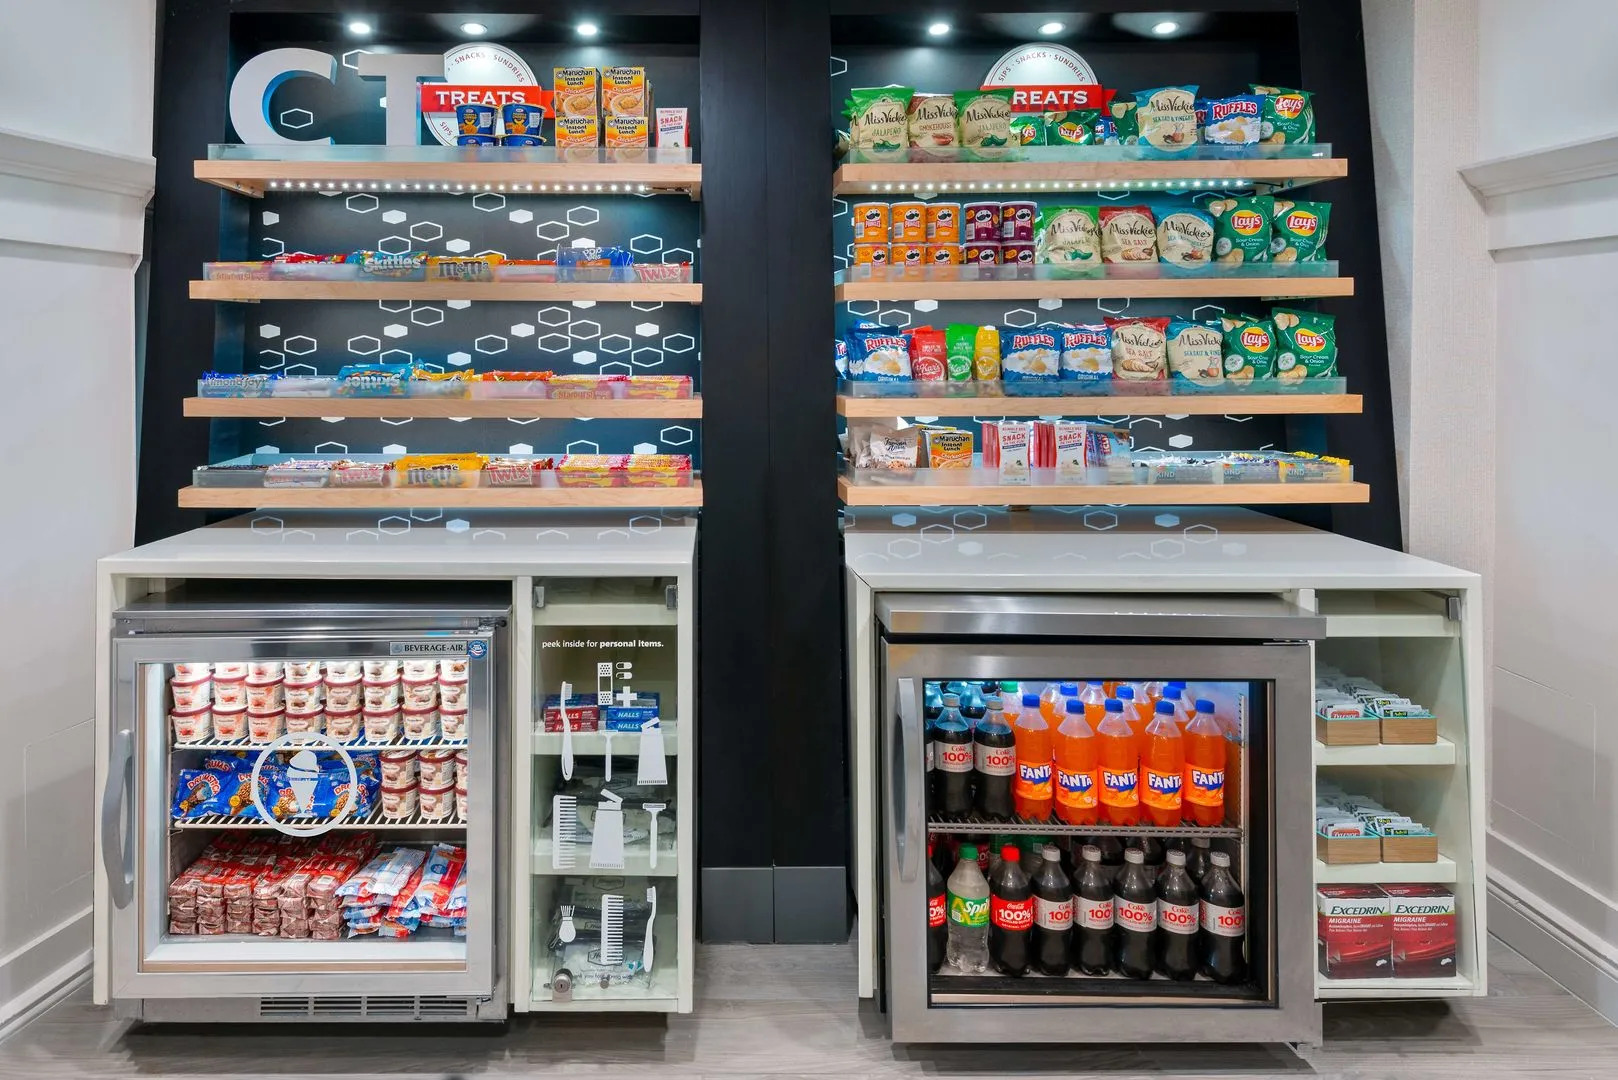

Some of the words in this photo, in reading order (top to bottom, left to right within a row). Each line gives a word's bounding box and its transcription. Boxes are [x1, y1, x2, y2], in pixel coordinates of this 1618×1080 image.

[998, 66, 1011, 82] SIPS
[1015, 51, 1047, 65] SNACKS
[1053, 54, 1086, 82] SUNDRIES
[435, 90, 526, 105] TREATS
[439, 121, 453, 136] SIPS
[455, 52, 486, 64] SNACKS
[493, 54, 525, 83] SUNDRIES
[1012, 90, 1088, 105] REATS
[1213, 101, 1258, 119] RUFFLES
[660, 115, 683, 125] SNACK
[1233, 214, 1261, 230] Lay's
[1289, 214, 1318, 230] Lay's
[364, 255, 421, 273] Skittles
[865, 336, 907, 351] RUFFLES
[1013, 333, 1055, 349] RUFFLES
[1064, 332, 1107, 347] RUFFLES
[1243, 332, 1268, 345] Lay's
[1297, 333, 1324, 348] Lay's
[1002, 432, 1026, 442] SNACK
[1058, 432, 1082, 442] SNACK
[490, 466, 531, 485] TWIX
[1287, 468, 1304, 476] KIND
[404, 644, 464, 652] BEVERAGE-AIR
[542, 639, 561, 648] peek
[562, 639, 584, 648] inside
[586, 639, 598, 647] for
[599, 639, 636, 649] personal
[638, 639, 664, 647] items.
[942, 751, 972, 762] 100%
[1058, 770, 1093, 787] FANTA
[1119, 907, 1153, 922] 100%
[1127, 903, 1146, 911] Coke
[1171, 905, 1189, 913] Coke
[1330, 905, 1385, 915] EXCEDRIN
[1395, 904, 1450, 914] EXCEDRIN
[1162, 910, 1196, 924] 100%
